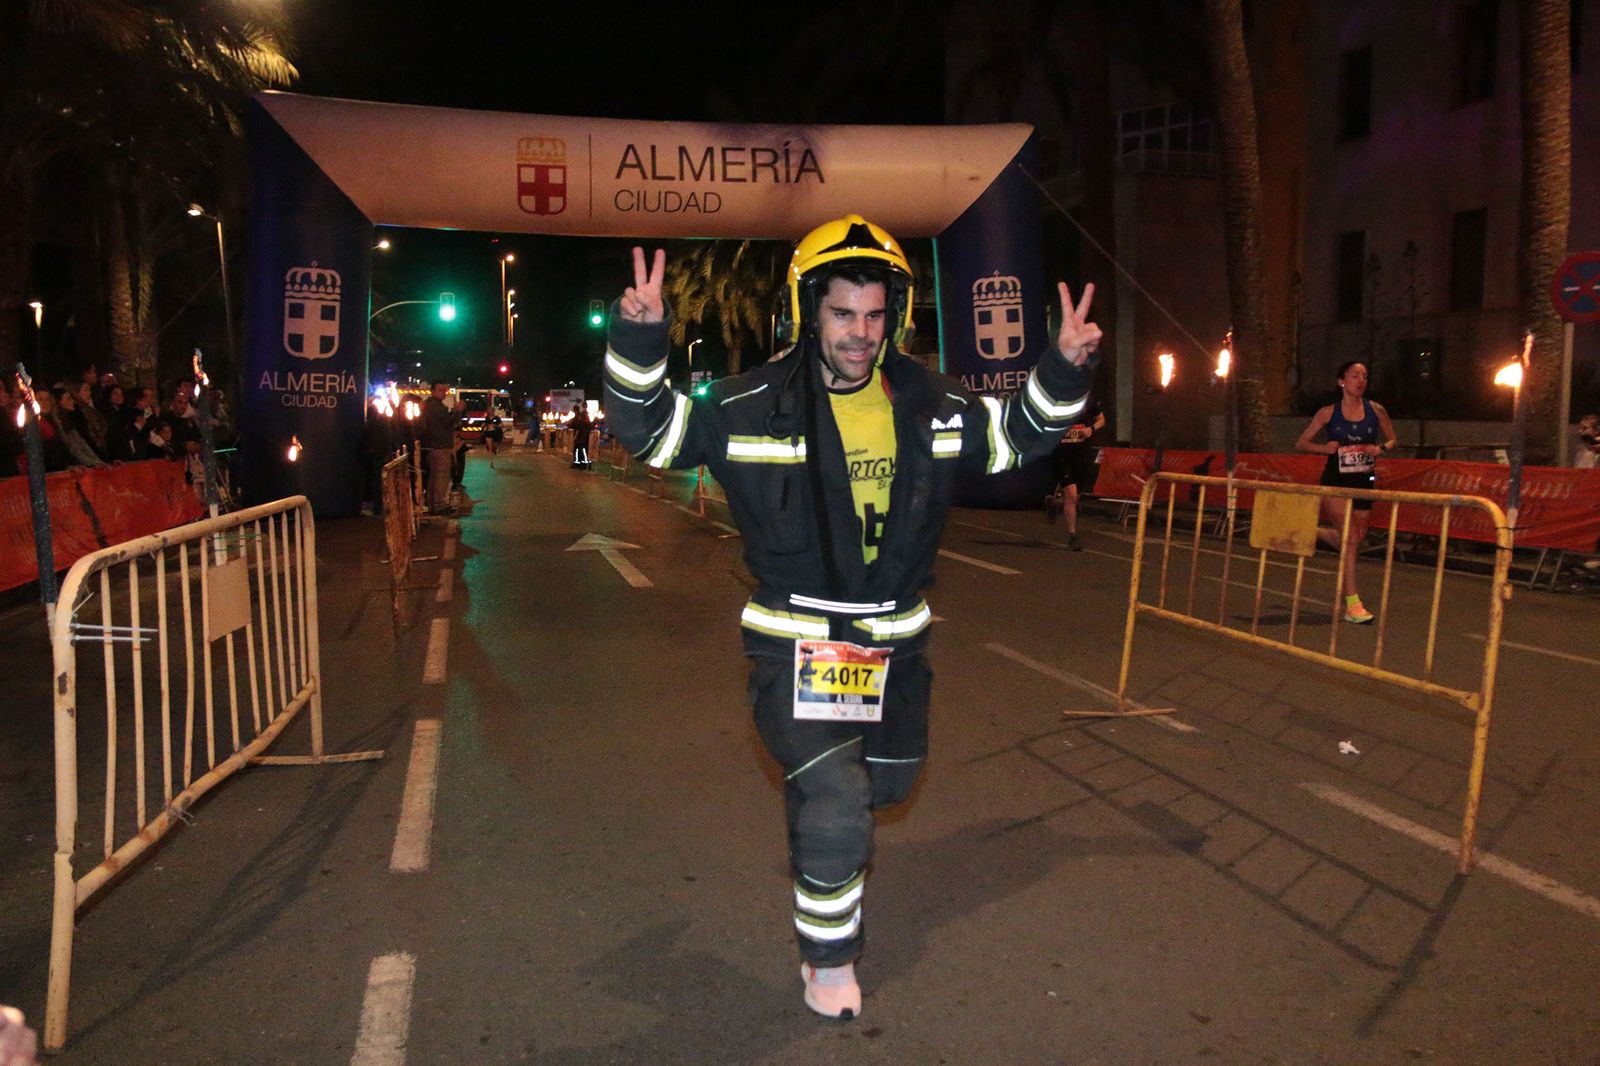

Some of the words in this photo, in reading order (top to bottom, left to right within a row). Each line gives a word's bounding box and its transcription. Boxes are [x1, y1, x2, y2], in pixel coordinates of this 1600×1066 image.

[615, 140, 825, 184] ALMERÍA
[613, 189, 722, 213] CIUDAD
[259, 370, 357, 393] ALMERÍA
[281, 393, 337, 408] CIUDAD
[849, 457, 896, 479] RTGY
[821, 666, 873, 686] 4017
